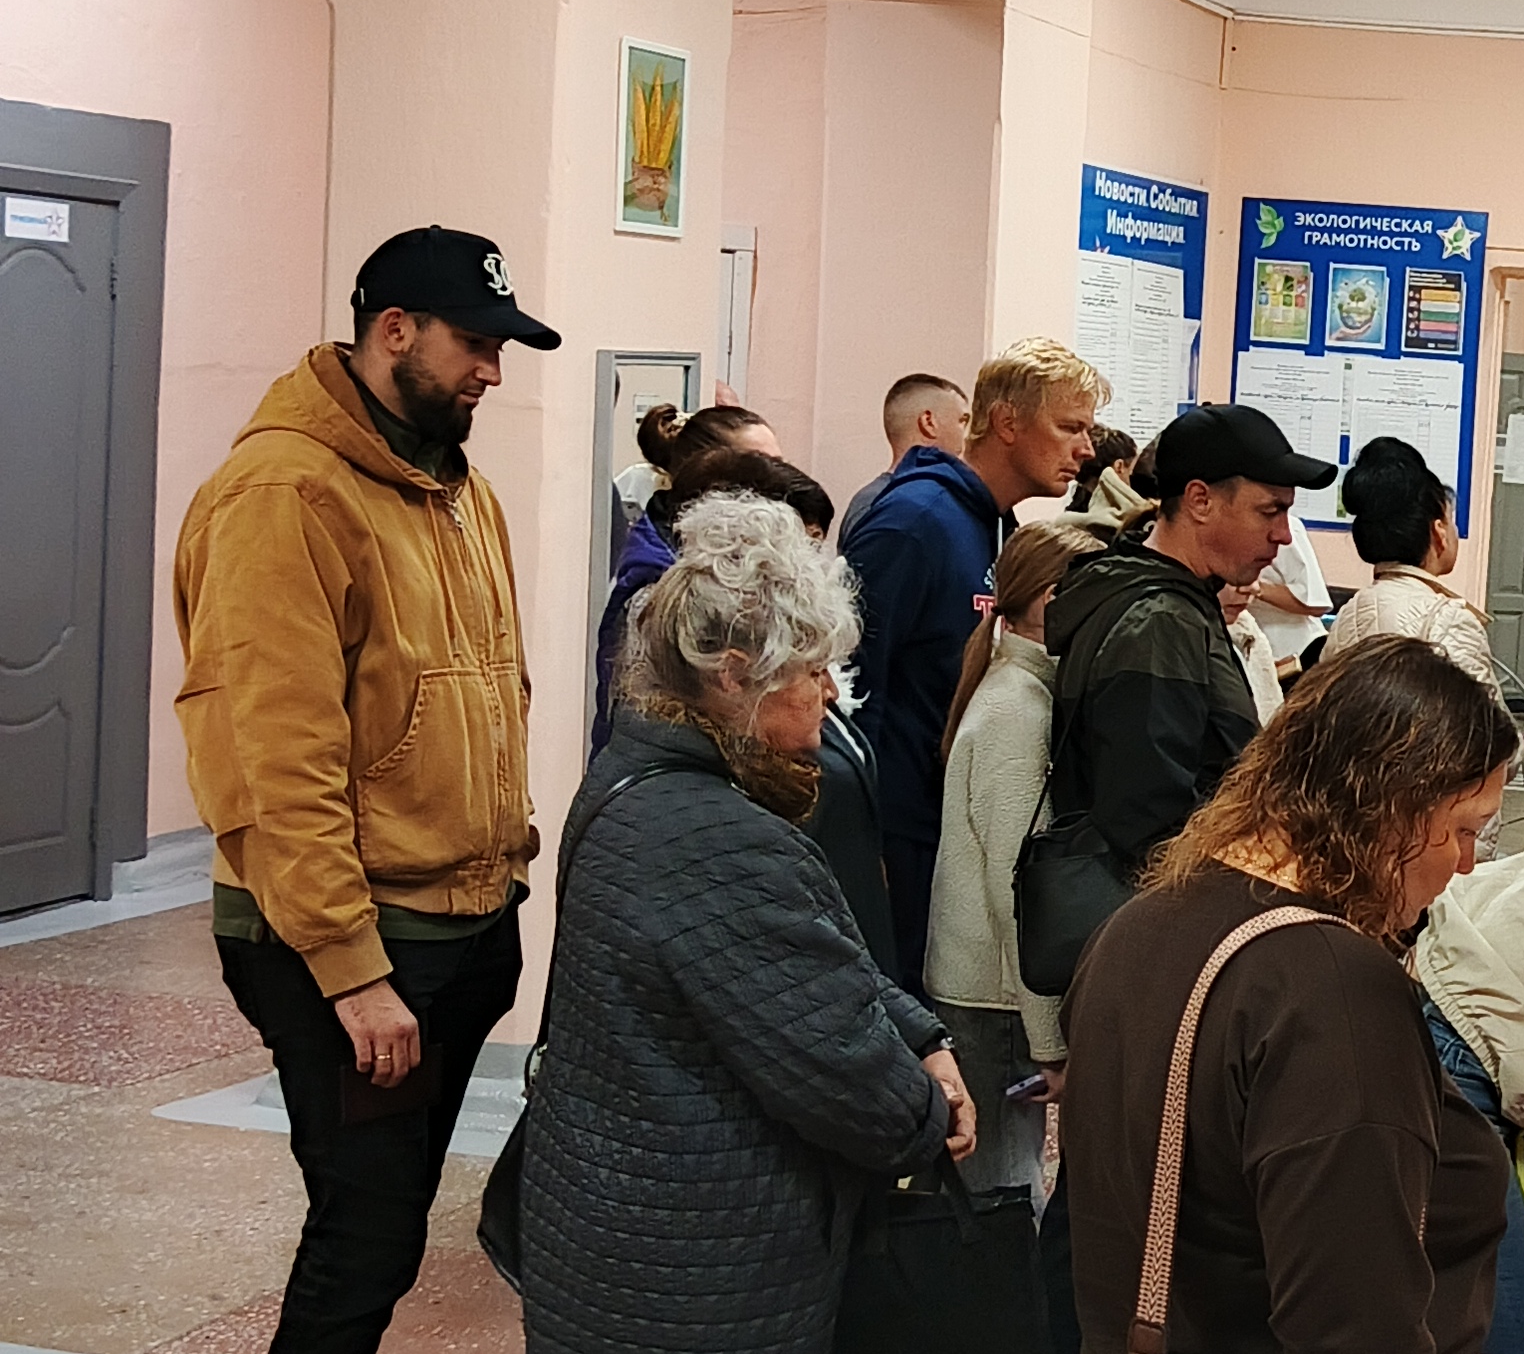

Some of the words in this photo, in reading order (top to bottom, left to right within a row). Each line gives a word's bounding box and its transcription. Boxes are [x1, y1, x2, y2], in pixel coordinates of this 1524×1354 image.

[1095, 170, 1148, 207] Новости.
[1150, 185, 1199, 217] События.
[1106, 209, 1186, 246] Информация.
[1294, 212, 1433, 233] ЭКОЛОГИЧЕСКАЯ
[1304, 231, 1421, 251] ГРАМОТНОСТЬ
